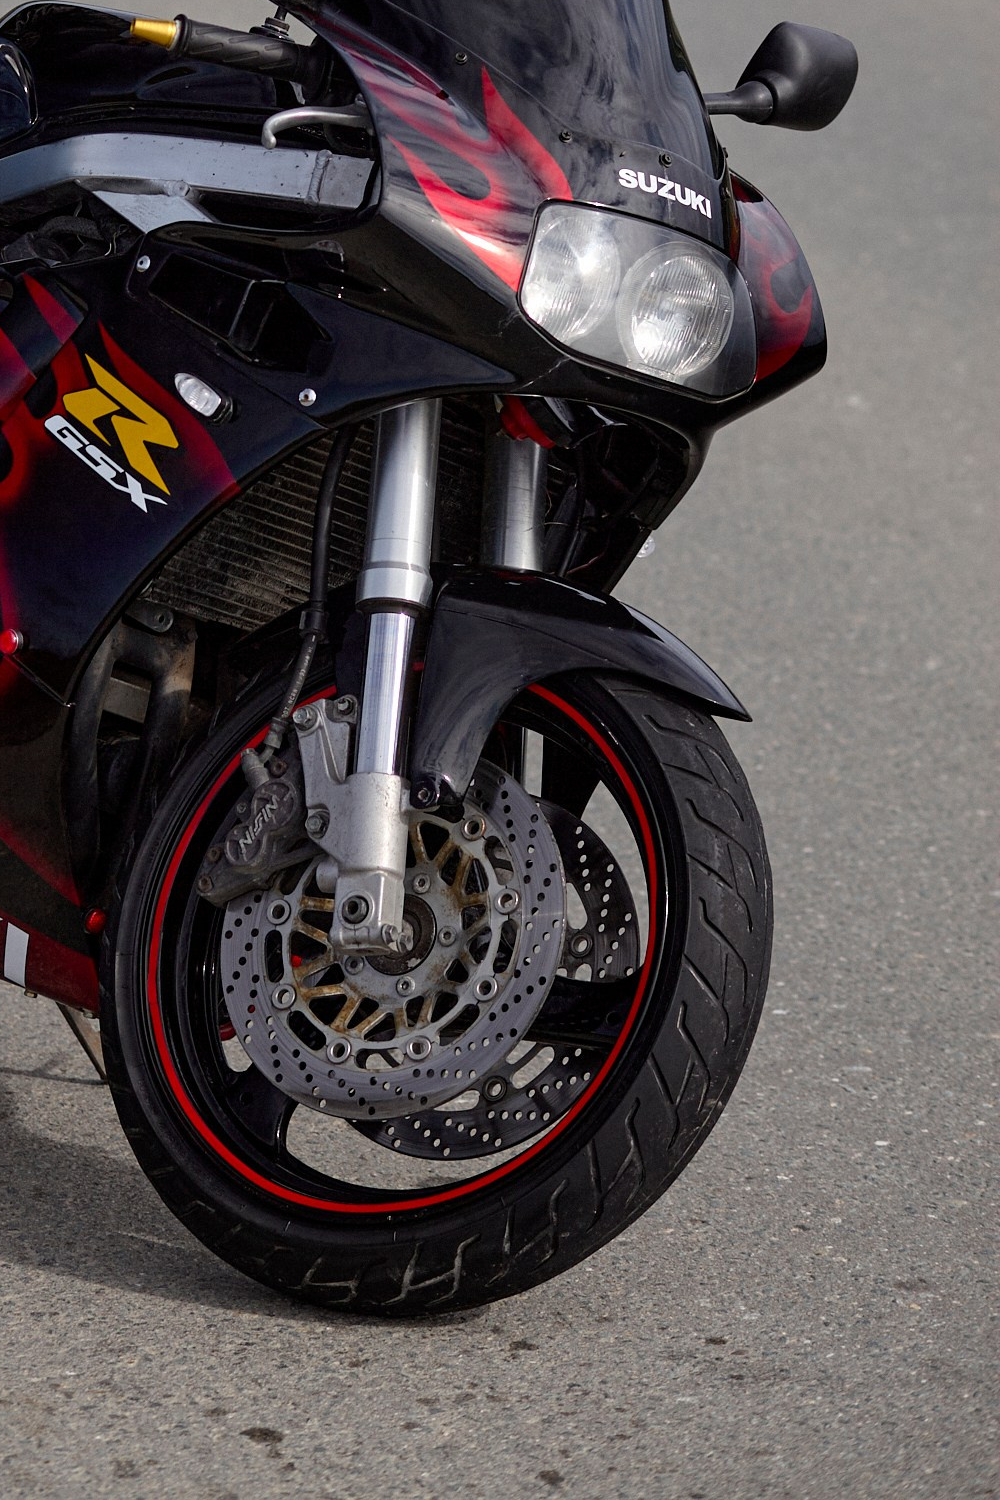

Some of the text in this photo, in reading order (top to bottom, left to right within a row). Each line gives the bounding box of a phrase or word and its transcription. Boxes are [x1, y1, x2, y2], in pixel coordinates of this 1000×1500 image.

[618, 168, 712, 219] SUZUKI
[44, 414, 169, 514] GSX
[239, 795, 280, 862] NISSIN
